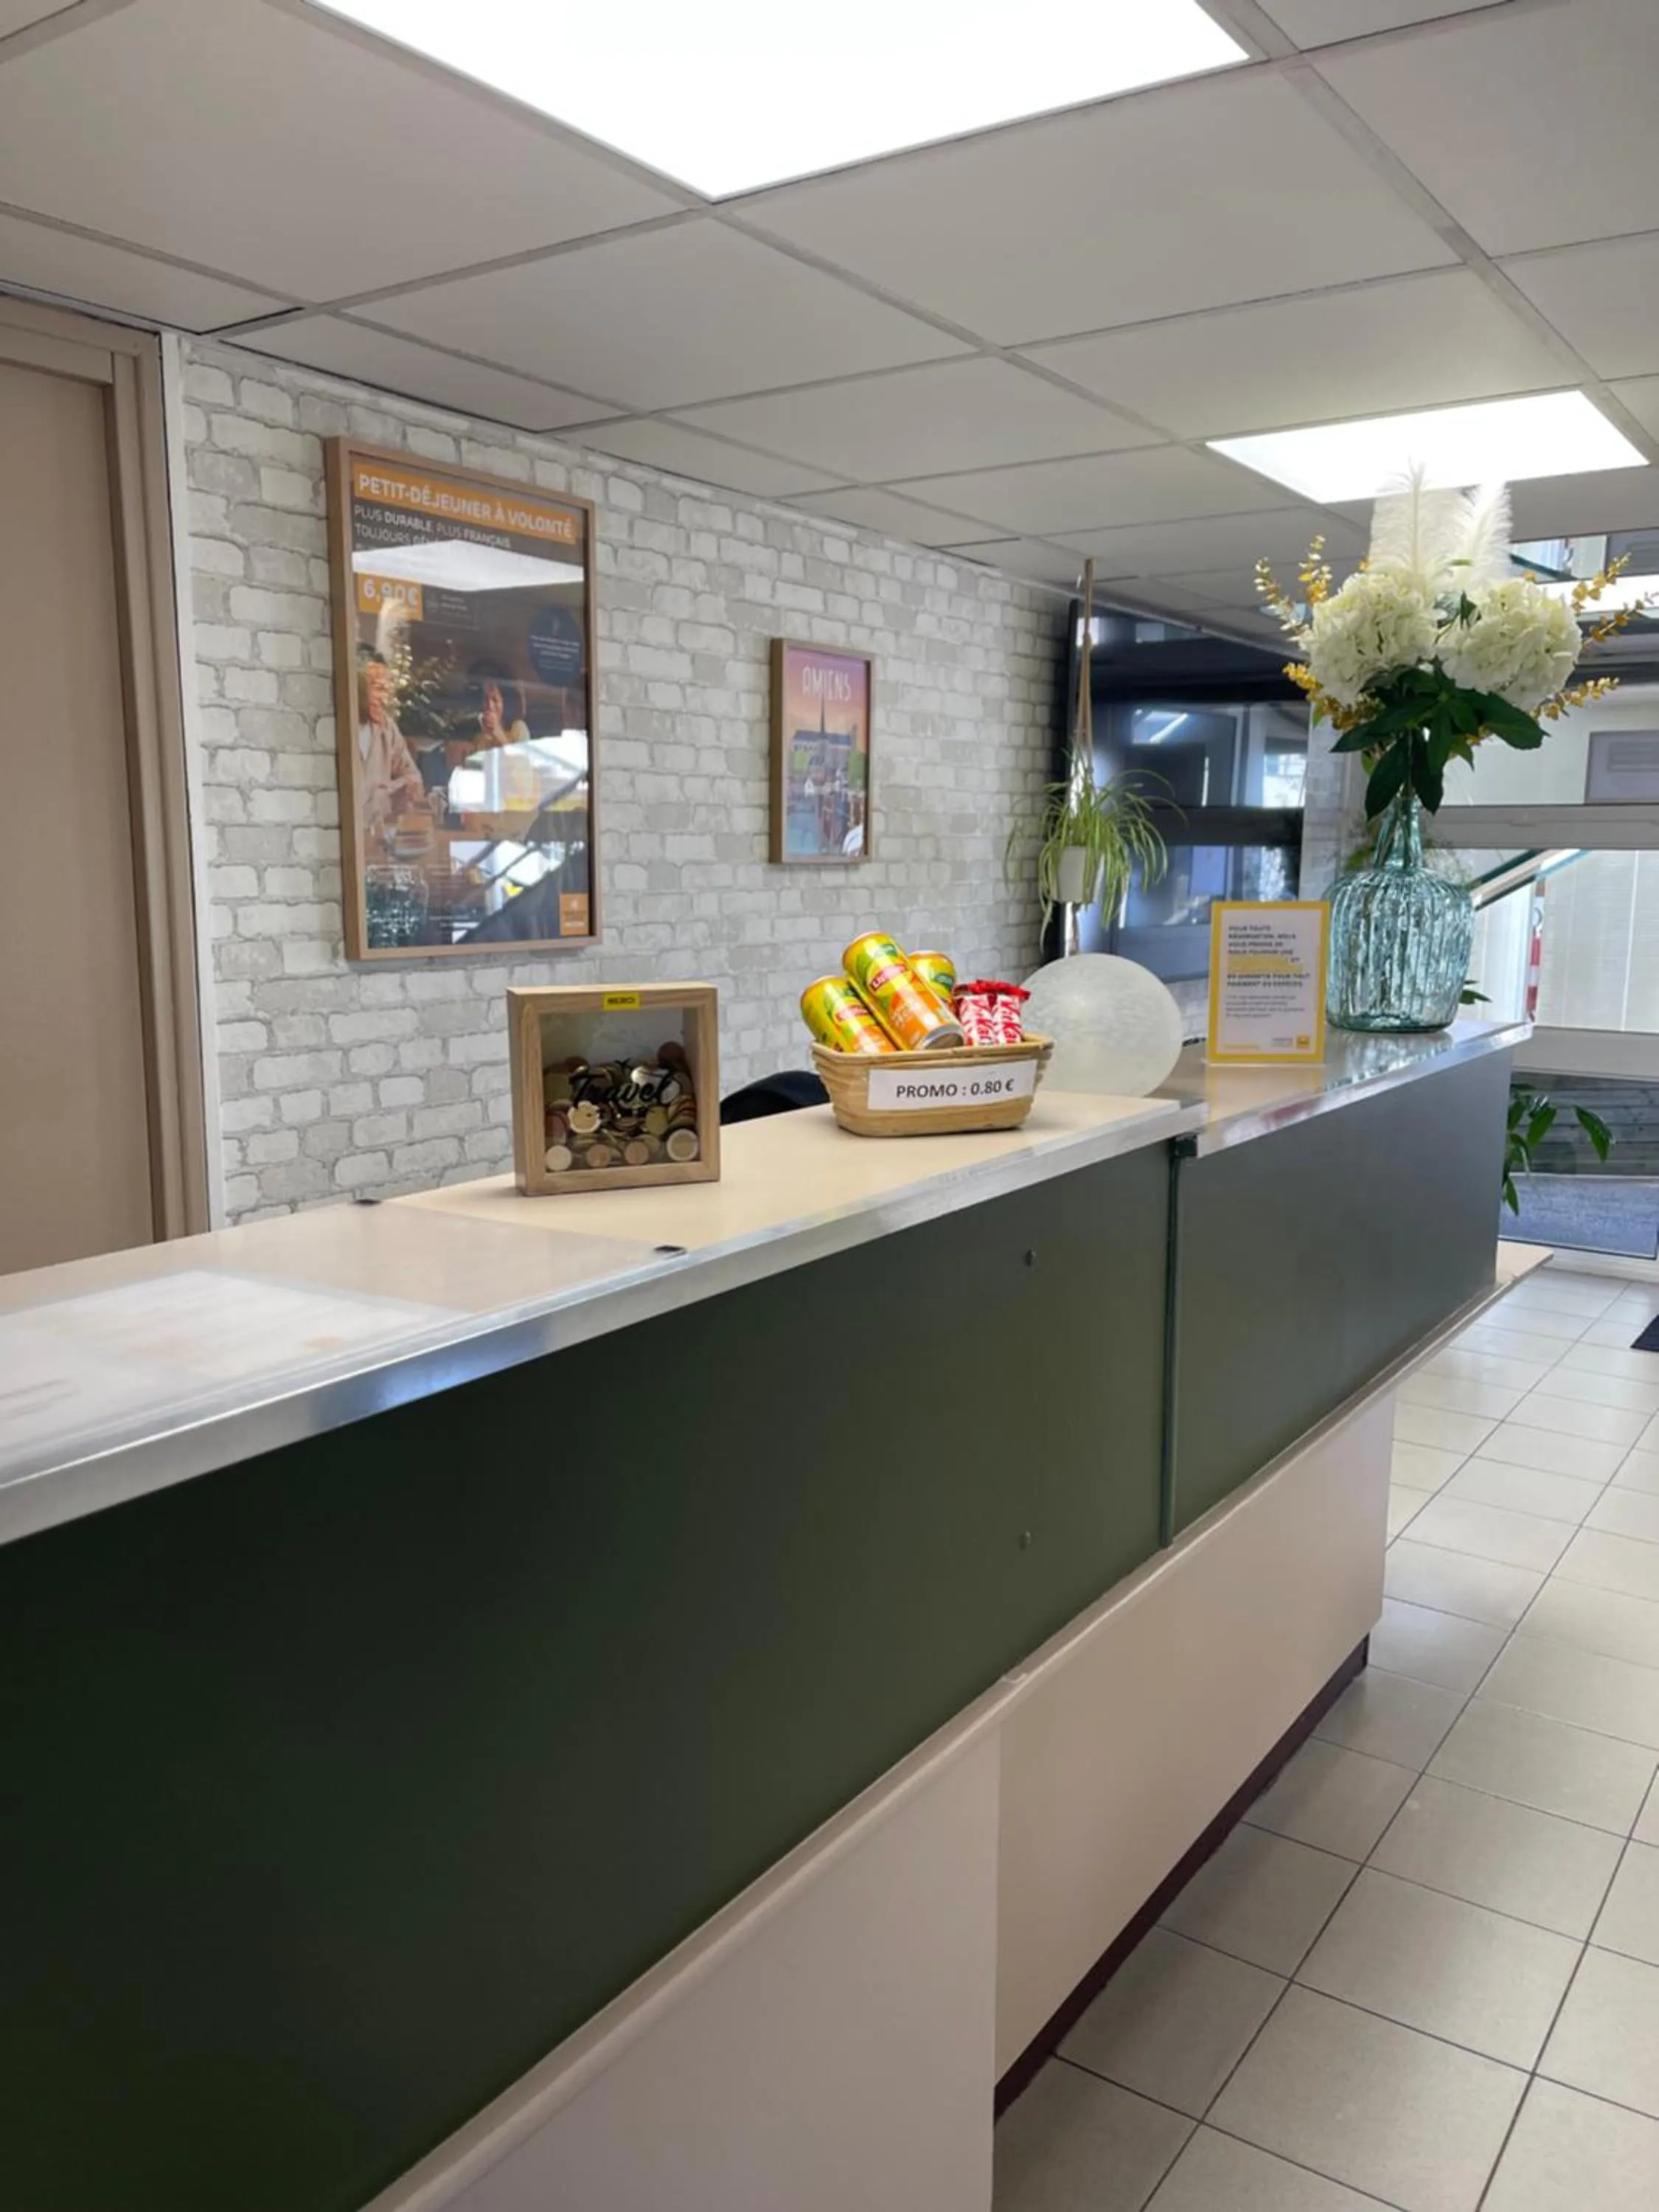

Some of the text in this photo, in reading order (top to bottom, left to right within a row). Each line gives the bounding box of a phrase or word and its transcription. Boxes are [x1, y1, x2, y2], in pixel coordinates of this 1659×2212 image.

[353, 504, 382, 521] PLUS
[358, 472, 572, 538] PETIT-DÉJEUNER À VOLONTÉ
[354, 522, 411, 545] TOUJOURS
[802, 666, 852, 702] AMIENS
[896, 1078, 1015, 1098] PROMO : 0.80 €
